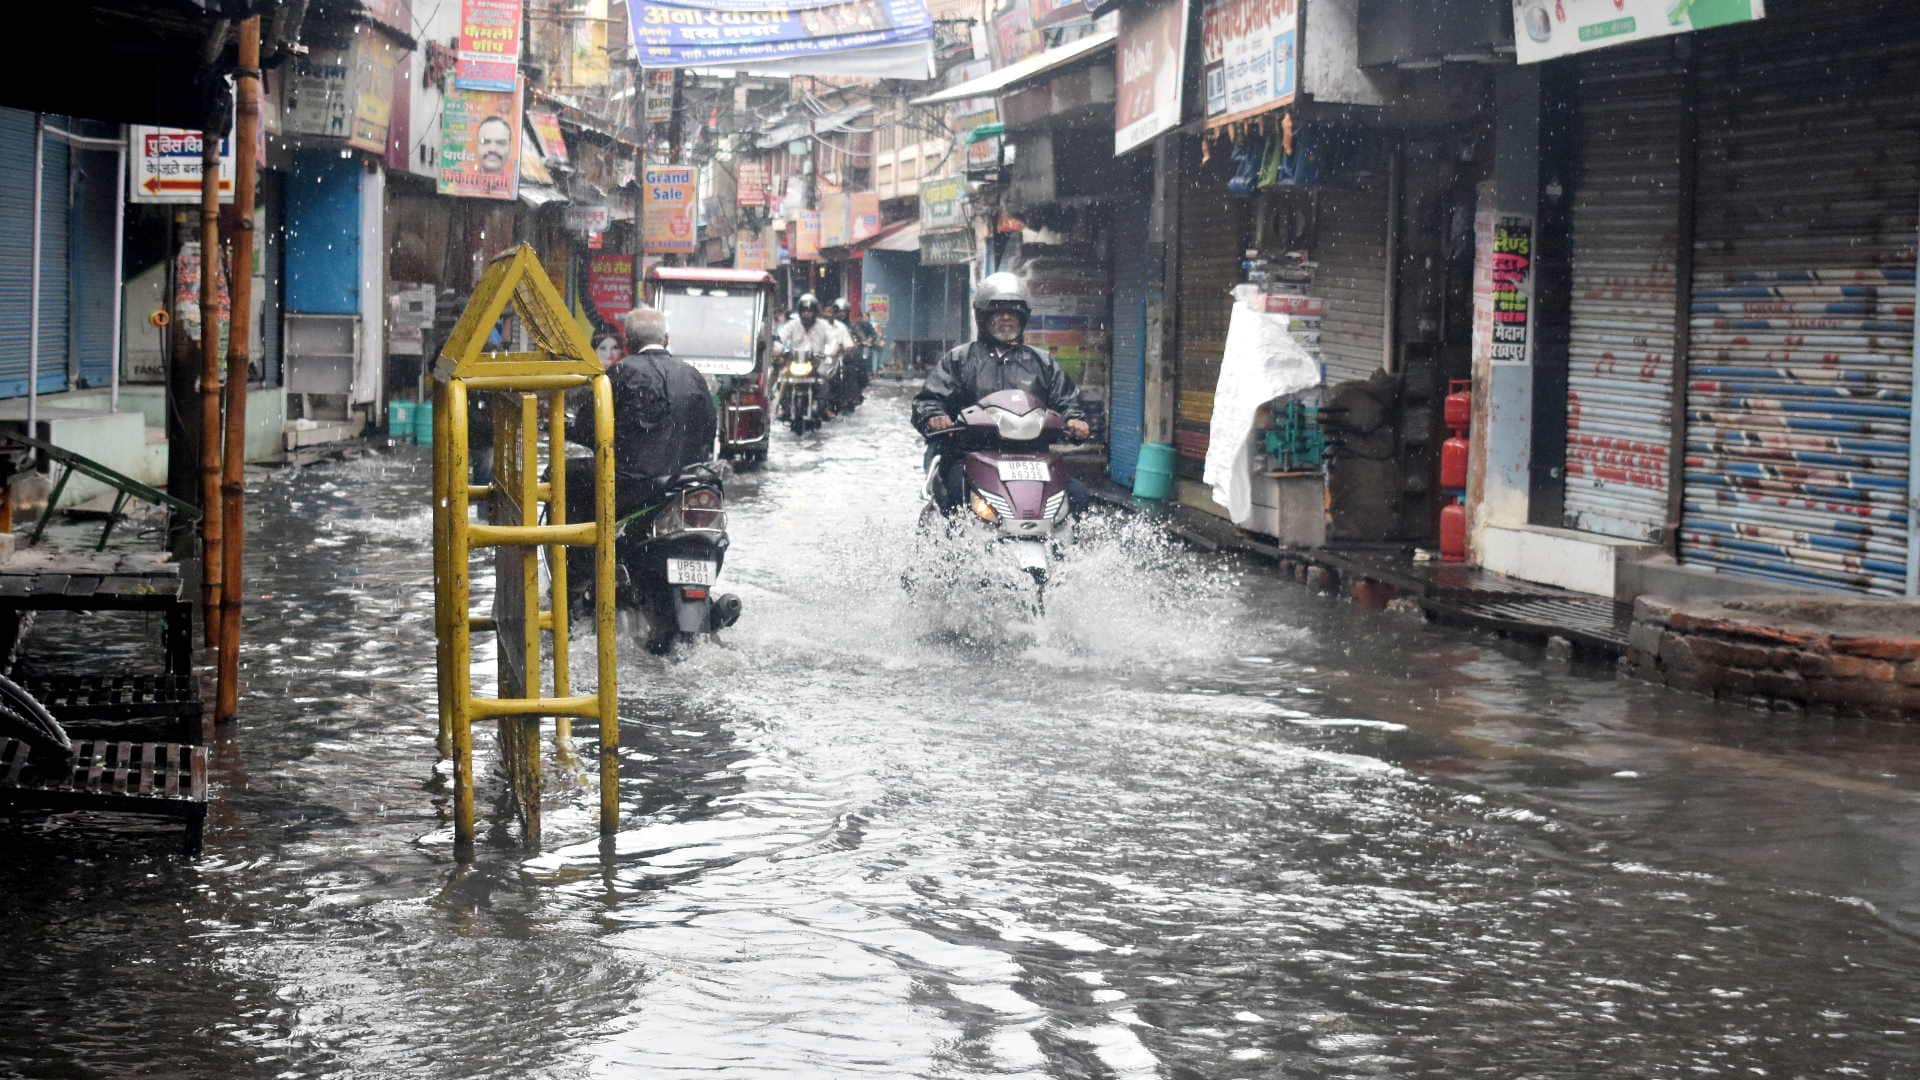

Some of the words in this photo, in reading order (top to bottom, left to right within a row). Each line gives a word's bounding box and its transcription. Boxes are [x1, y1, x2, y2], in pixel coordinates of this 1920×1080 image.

[643, 5, 790, 26] अनारकली
[147, 135, 182, 157] पुलिस
[646, 171, 690, 185] Grand
[652, 187, 683, 200] Sale
